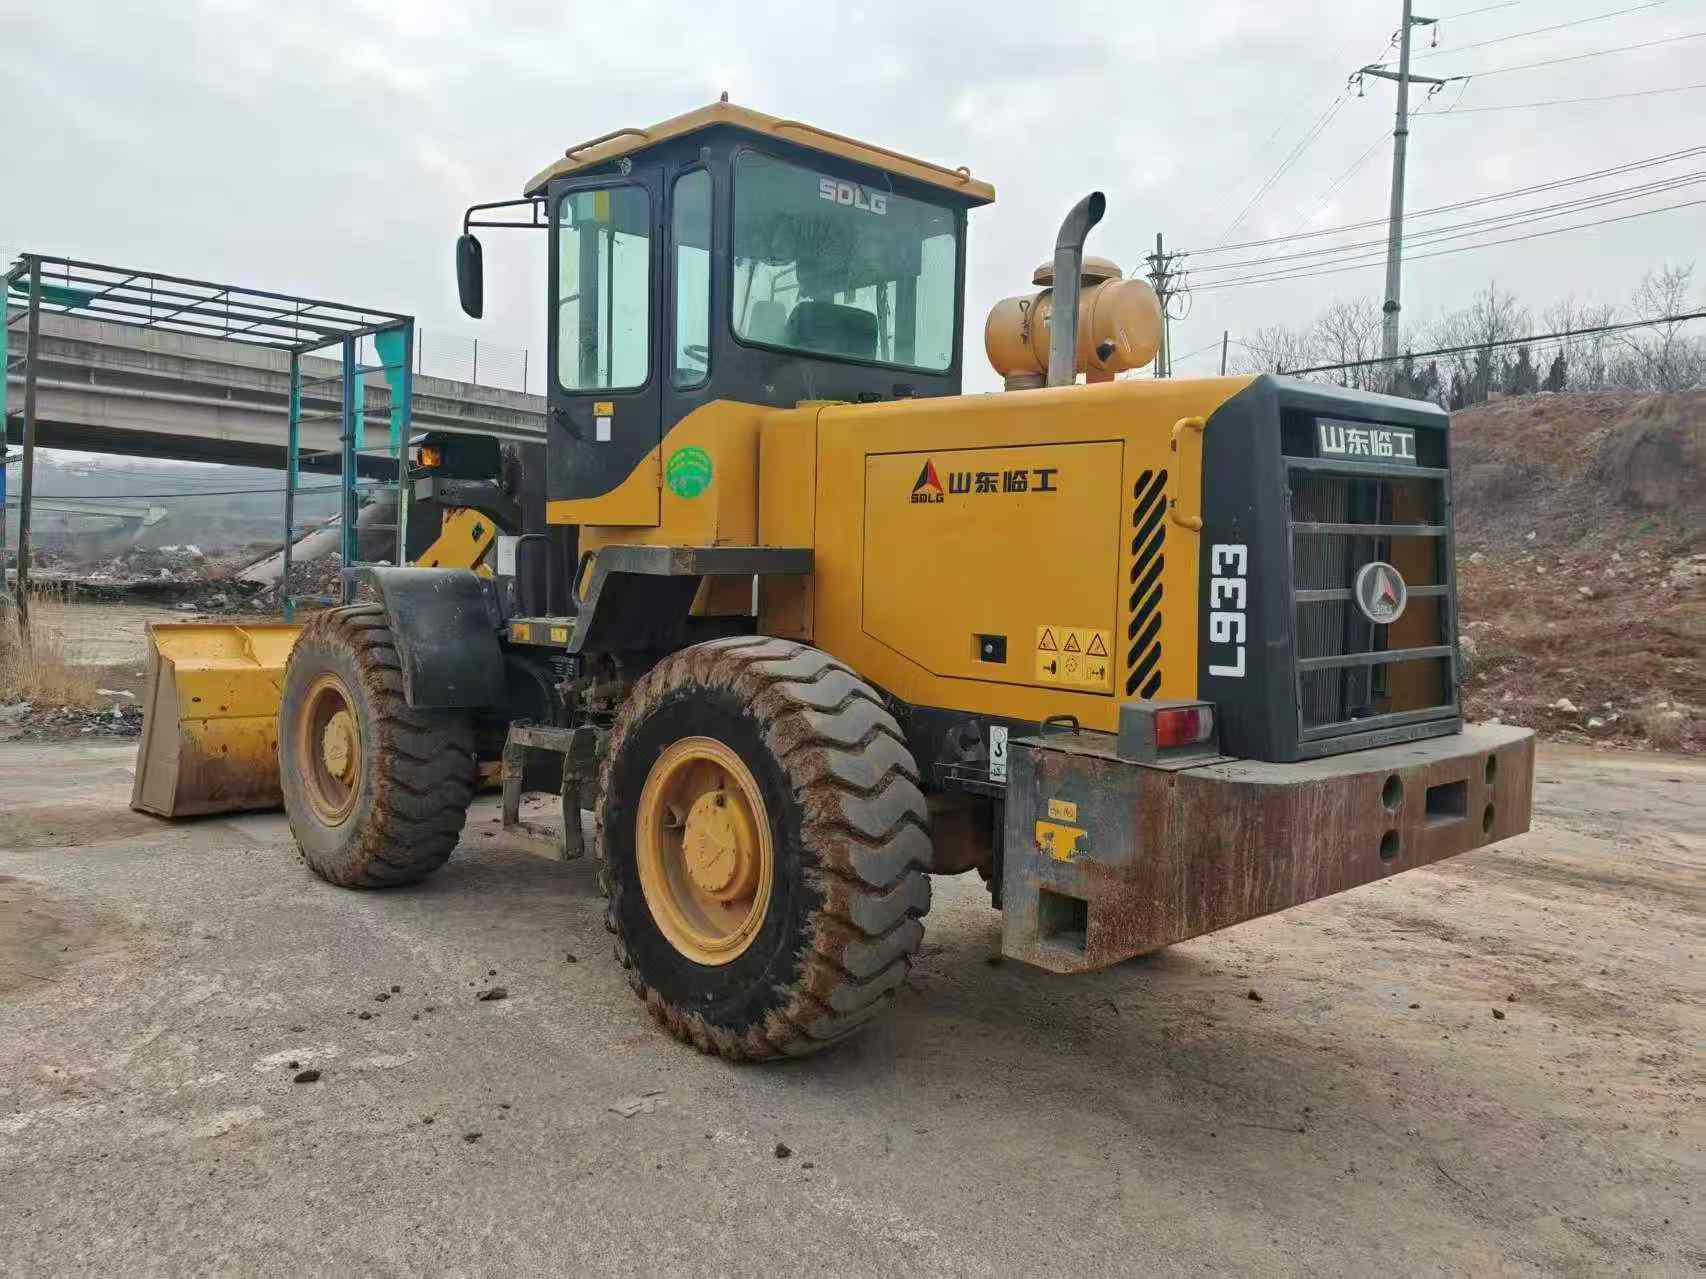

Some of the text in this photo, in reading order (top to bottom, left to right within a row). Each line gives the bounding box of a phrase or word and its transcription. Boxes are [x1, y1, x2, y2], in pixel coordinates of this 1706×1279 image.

[819, 178, 887, 215] SDLG
[1320, 425, 1416, 458] 山东临工
[949, 468, 1058, 494] 山东临工
[910, 493, 944, 504] SDLG
[1209, 544, 1247, 677] L933
